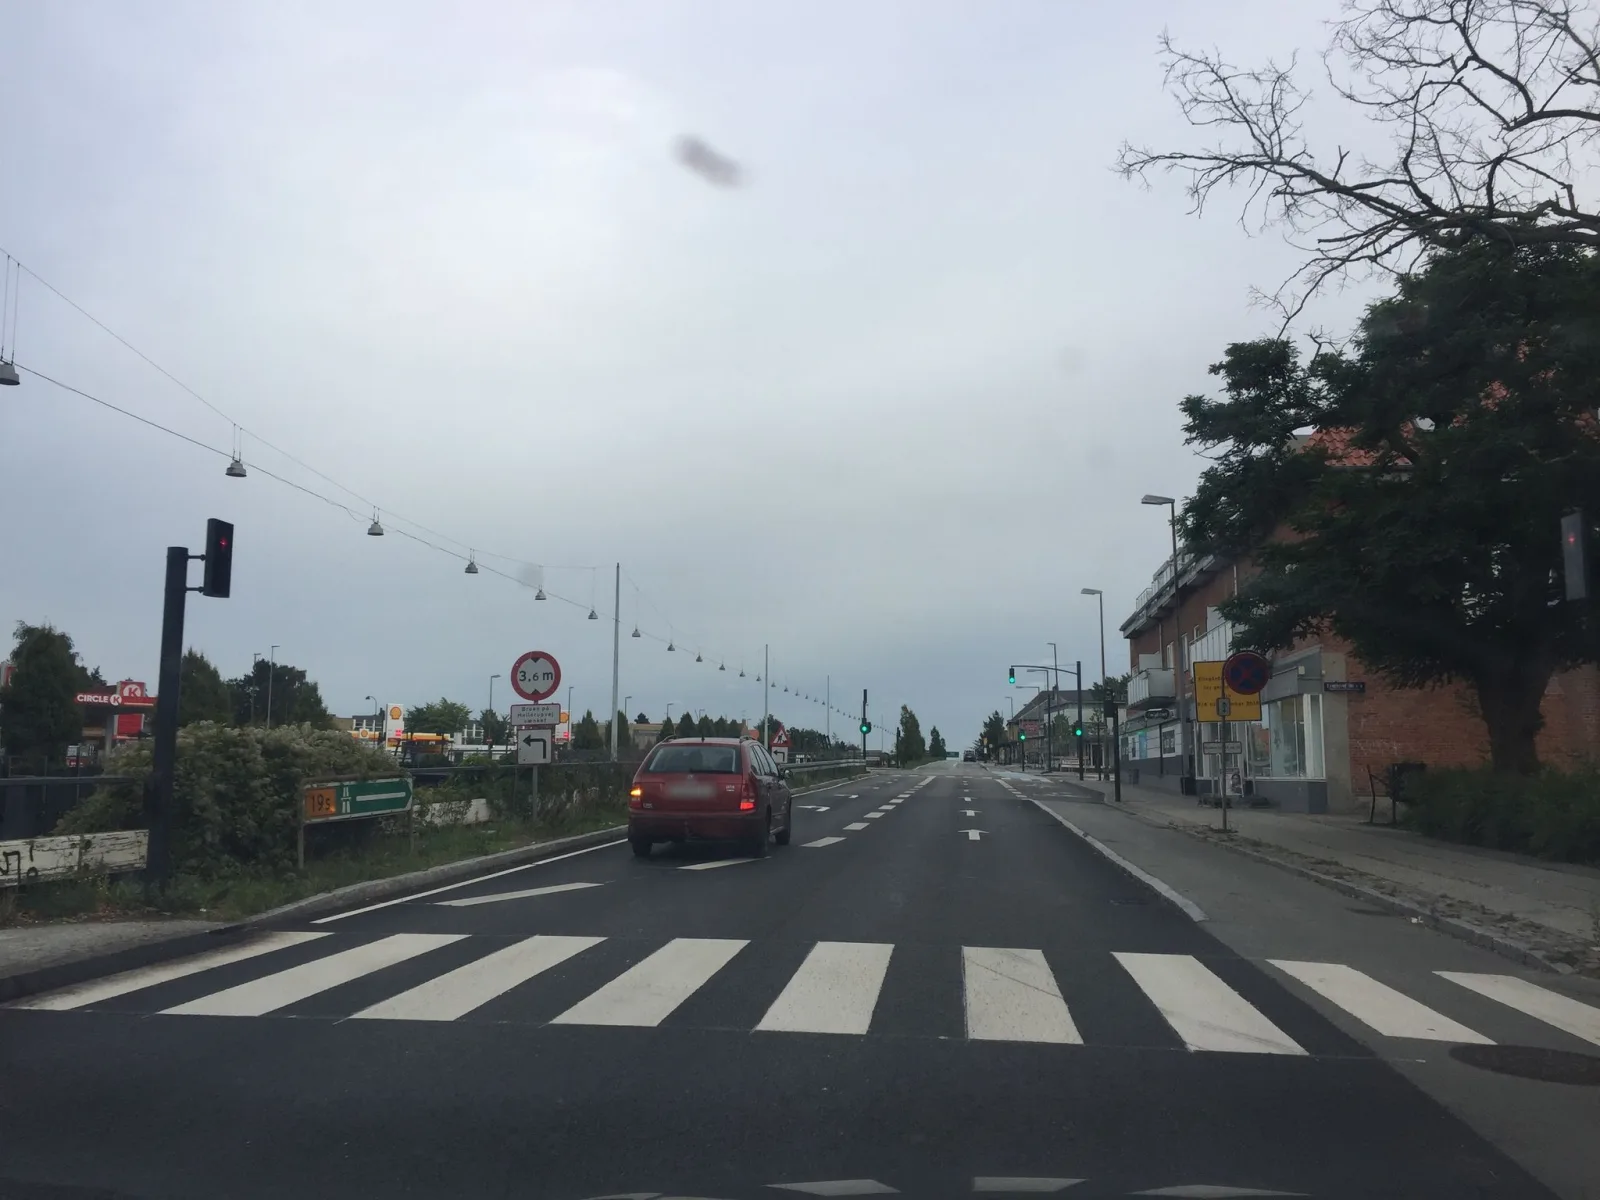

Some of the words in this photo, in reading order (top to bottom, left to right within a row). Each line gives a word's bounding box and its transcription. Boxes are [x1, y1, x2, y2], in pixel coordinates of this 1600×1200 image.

[519, 670, 539, 682] 3,6
[543, 672, 553, 681] m
[77, 694, 109, 703] CIRCLE
